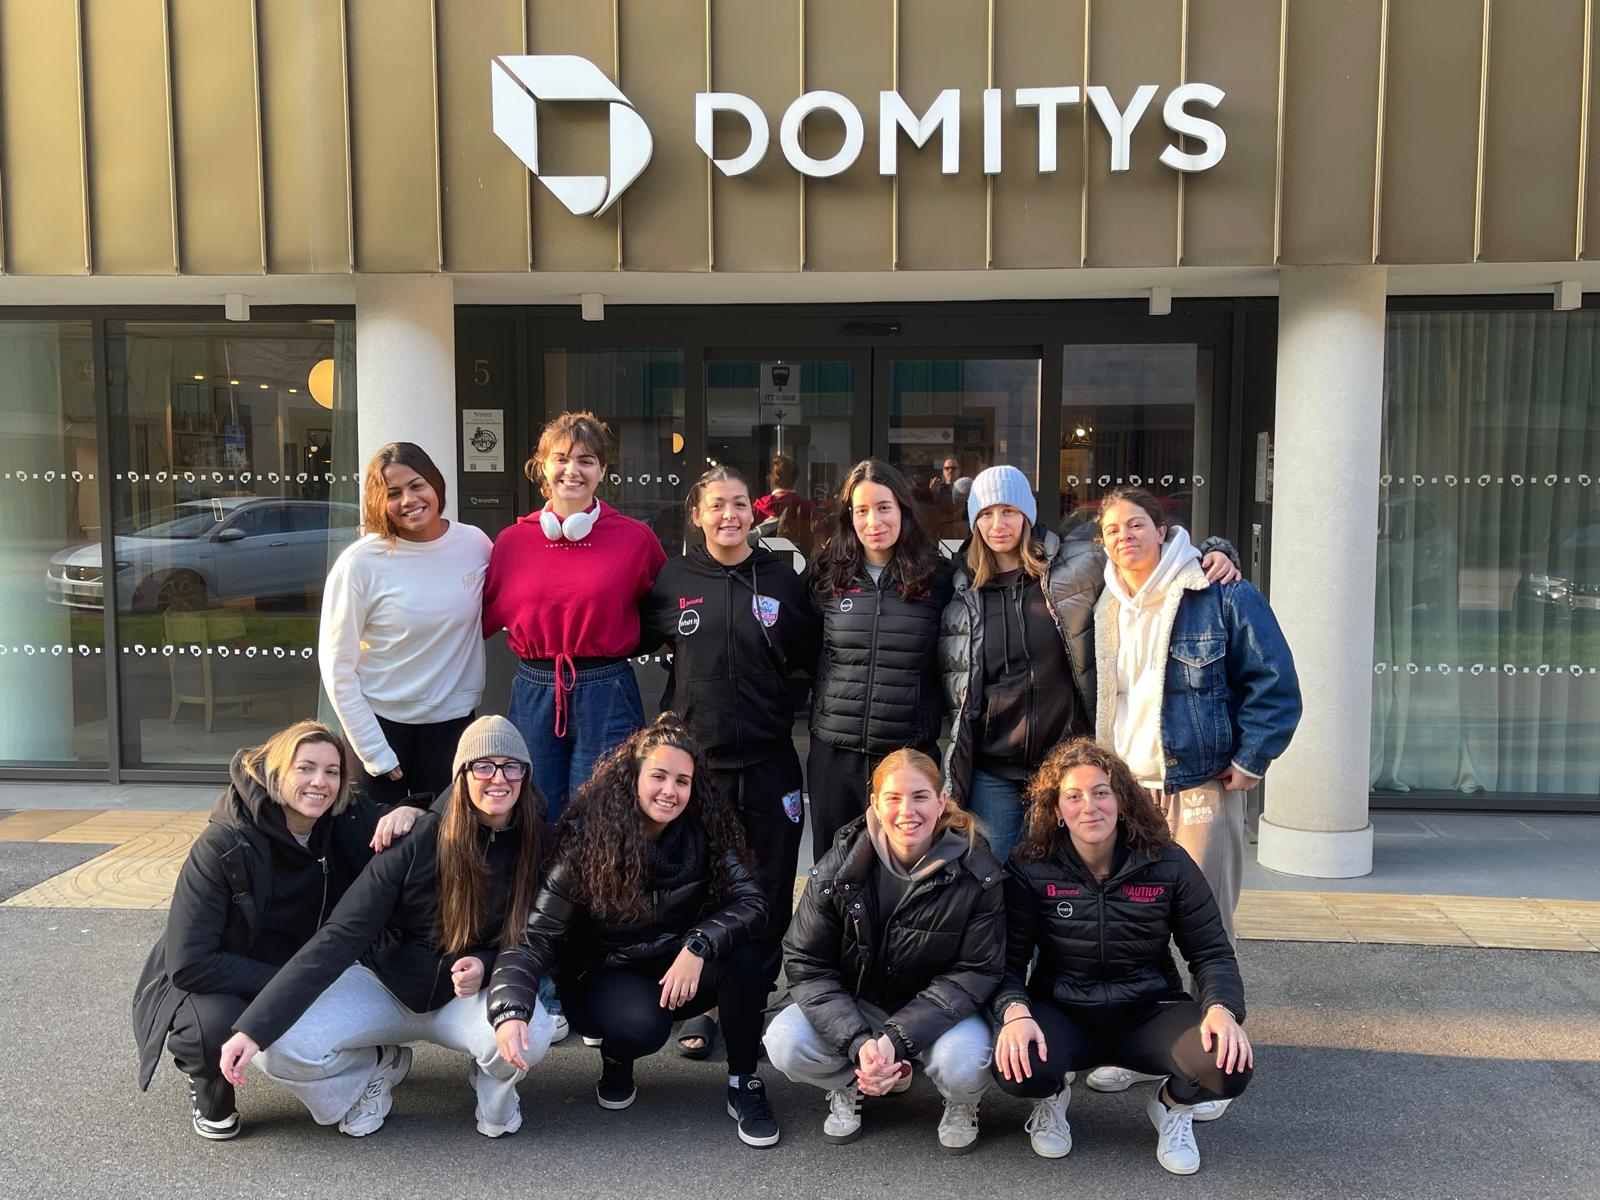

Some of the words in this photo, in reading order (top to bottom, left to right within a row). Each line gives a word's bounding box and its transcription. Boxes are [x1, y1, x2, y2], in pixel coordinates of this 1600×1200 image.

[695, 82, 1227, 177] DOMITYS
[474, 359, 491, 386] 5
[1122, 883, 1165, 898] NAUTILUS
